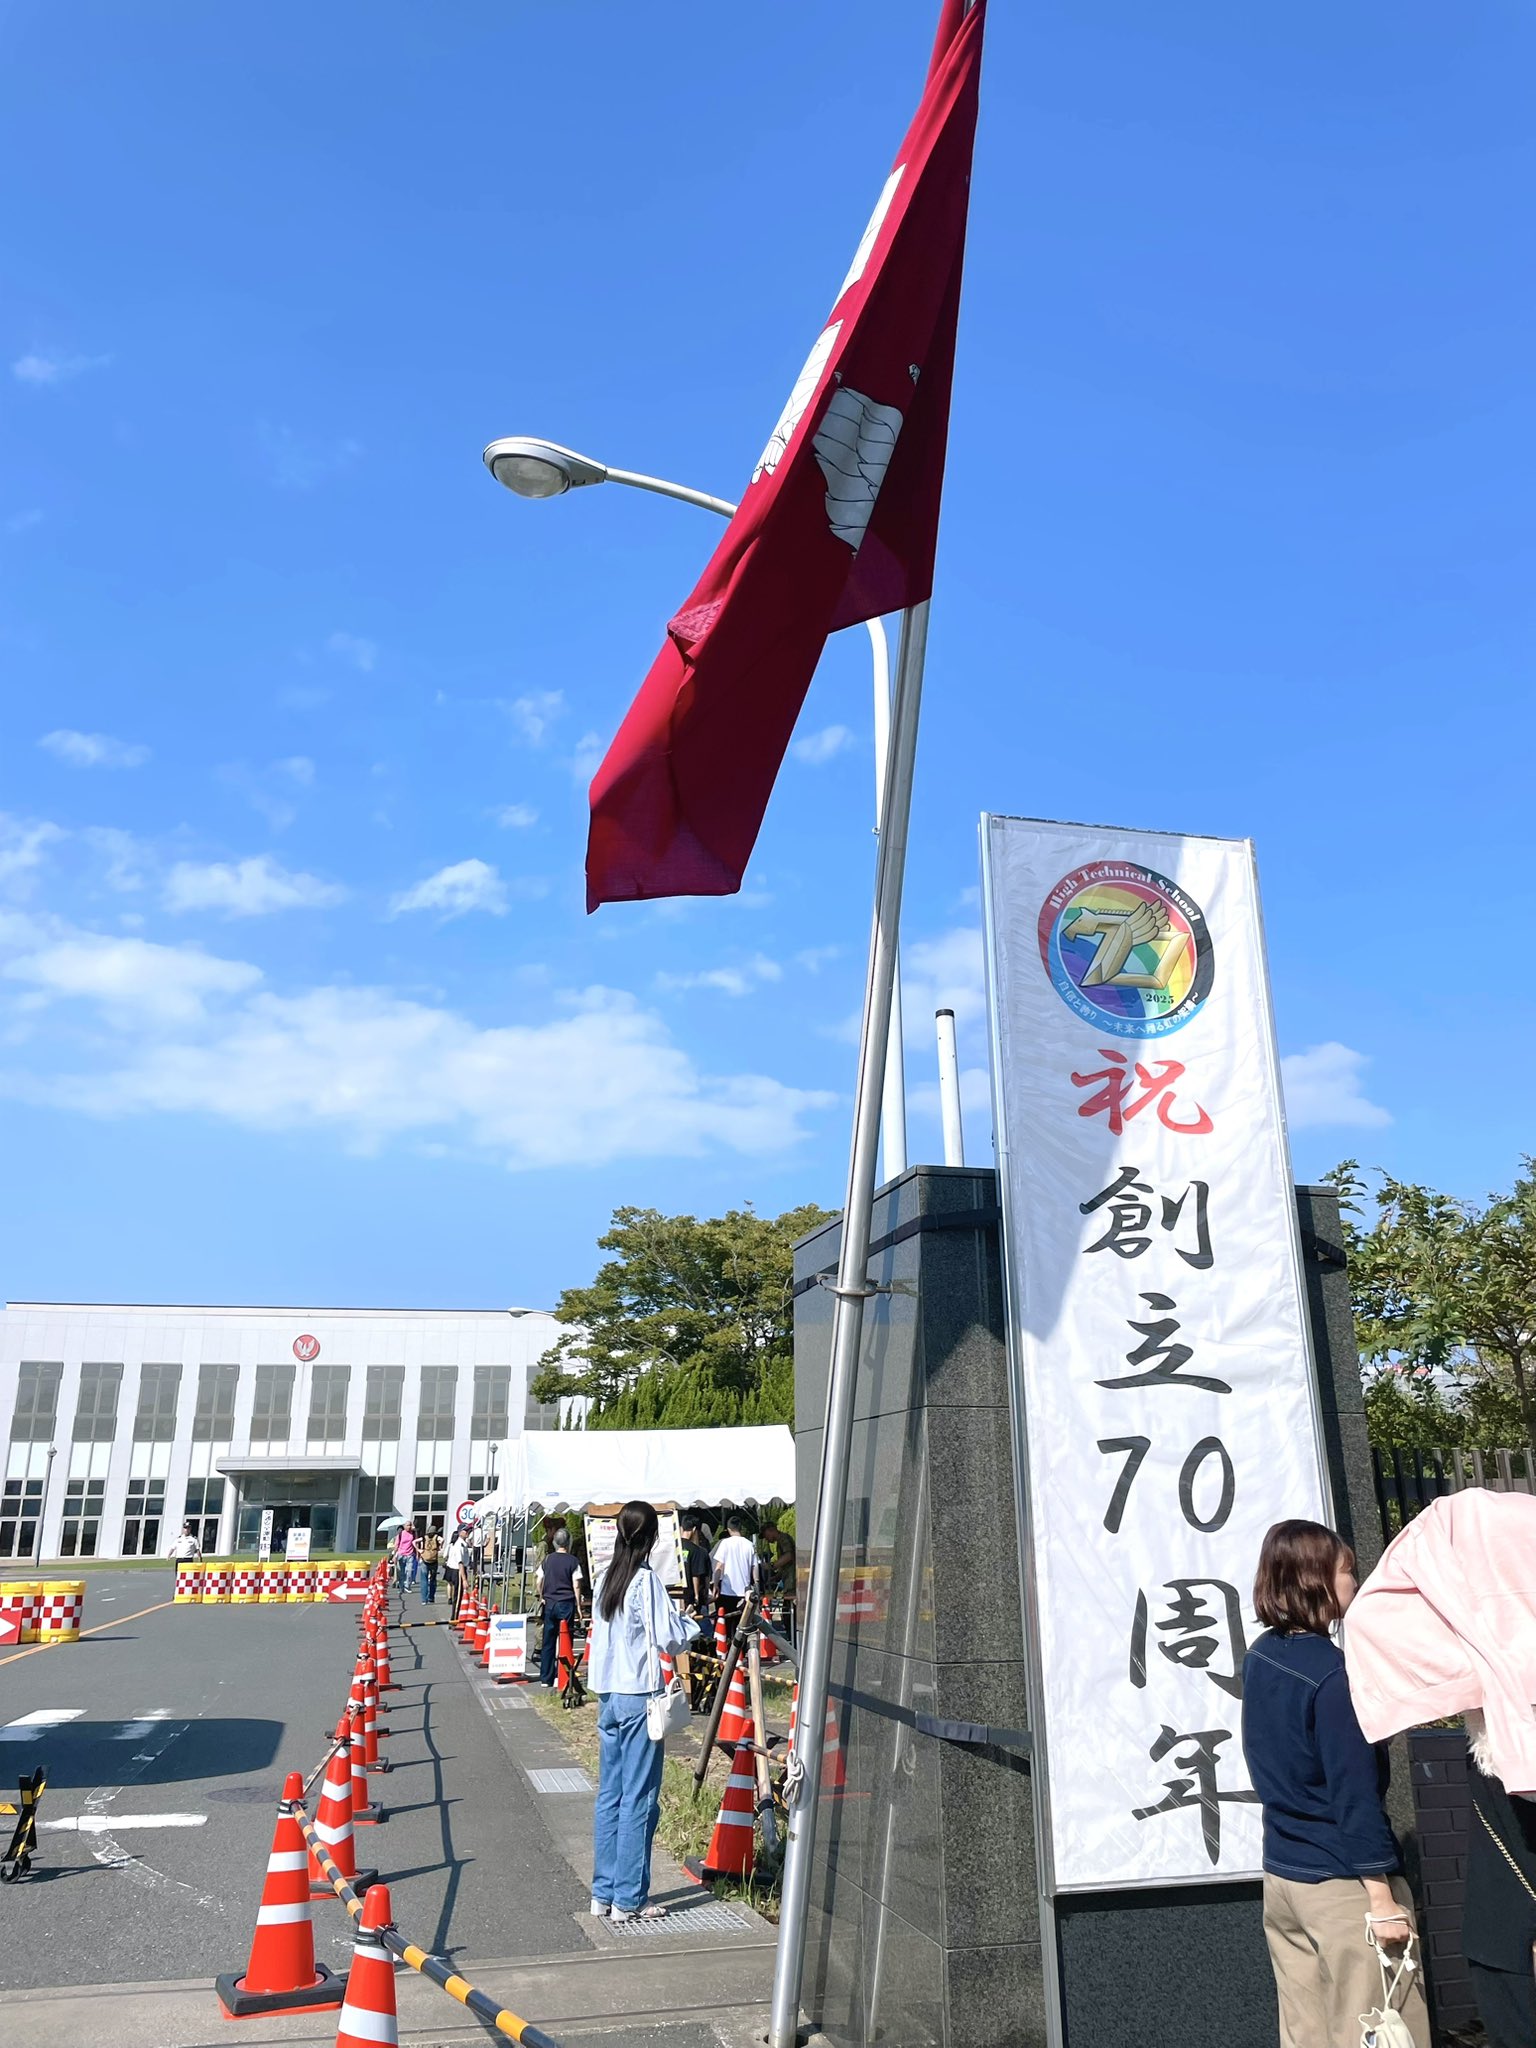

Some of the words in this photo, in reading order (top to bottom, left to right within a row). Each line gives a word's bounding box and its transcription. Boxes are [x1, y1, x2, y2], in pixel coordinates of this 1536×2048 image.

[1049, 879, 1078, 910] High
[1078, 865, 1153, 884] Technical
[1156, 879, 1202, 922] School
[1145, 993, 1175, 1005] 2025
[461, 1508, 476, 1520] 30
